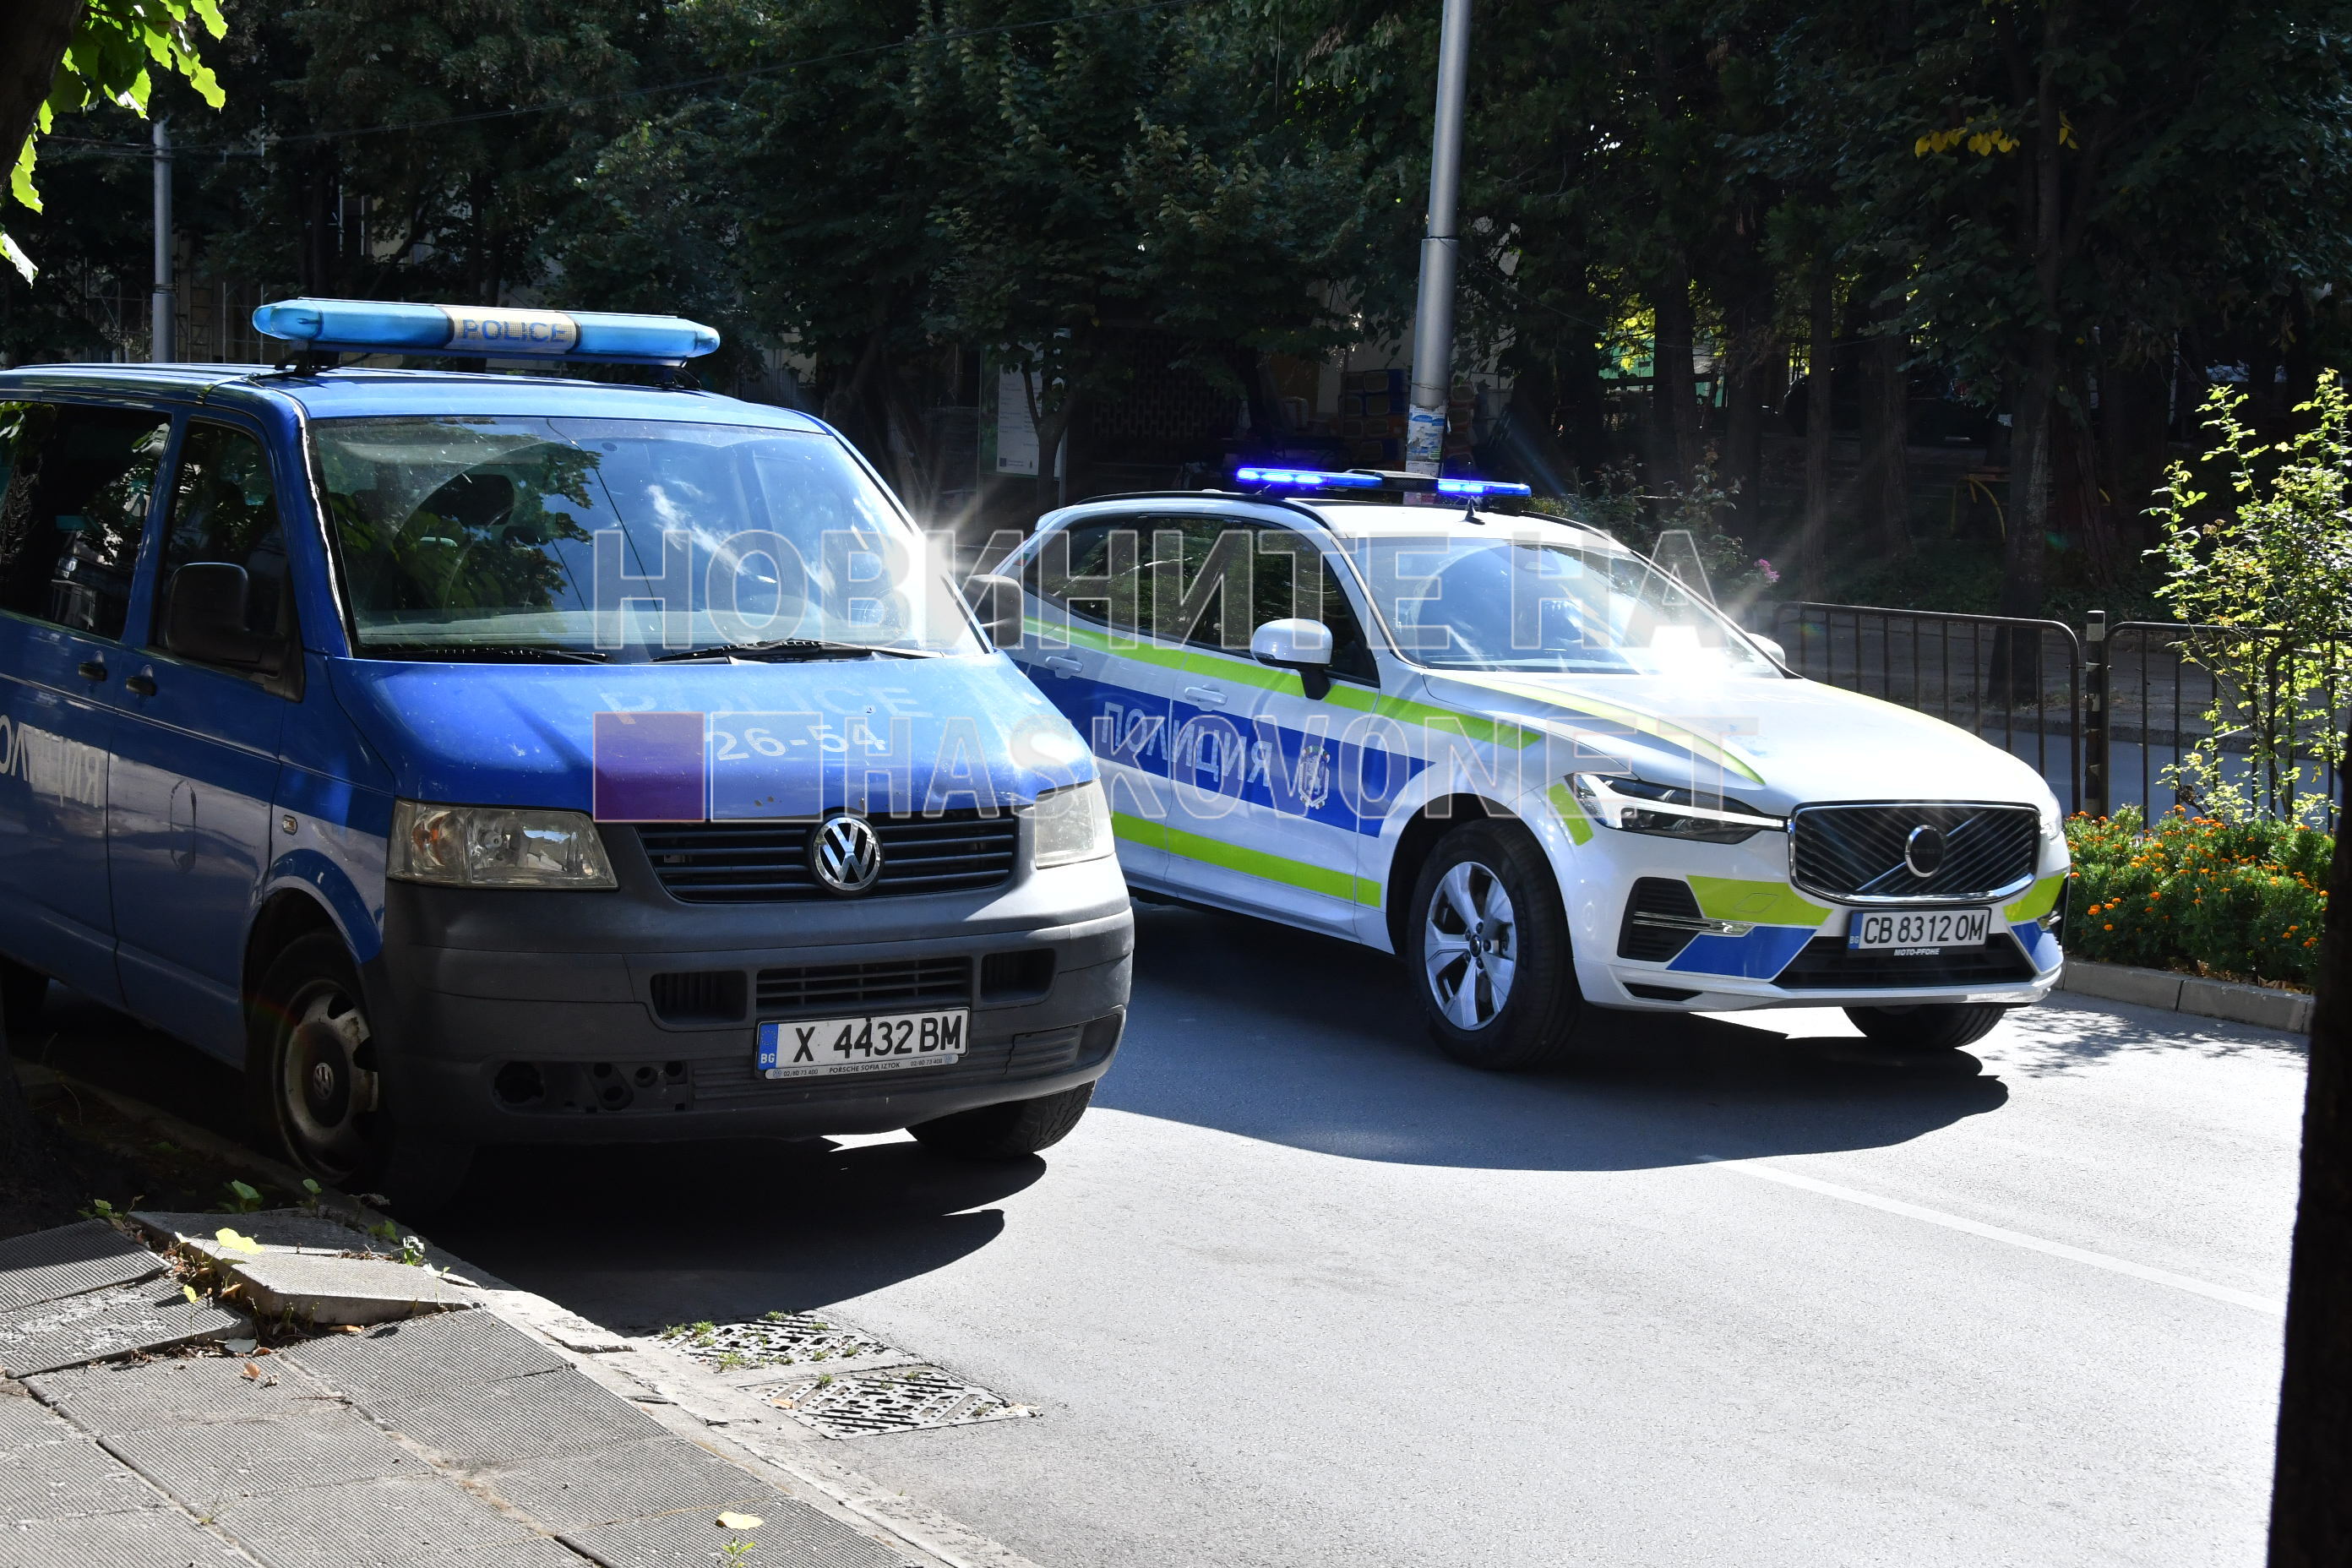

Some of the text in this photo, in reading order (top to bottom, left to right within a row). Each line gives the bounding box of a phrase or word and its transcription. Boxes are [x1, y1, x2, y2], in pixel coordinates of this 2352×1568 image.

[462, 318, 569, 342] POLICE
[705, 724, 886, 760] 26-54
[1101, 701, 1273, 787] ПОЛИЦИЯ
[1849, 935, 1859, 945] BG
[1864, 914, 1985, 945] CB 8312 OM
[1894, 948, 1941, 956] MOTO-PFOHE
[792, 1015, 962, 1063] X 4432 BM
[760, 1053, 776, 1064] BG
[829, 1065, 860, 1074] PORSCHE
